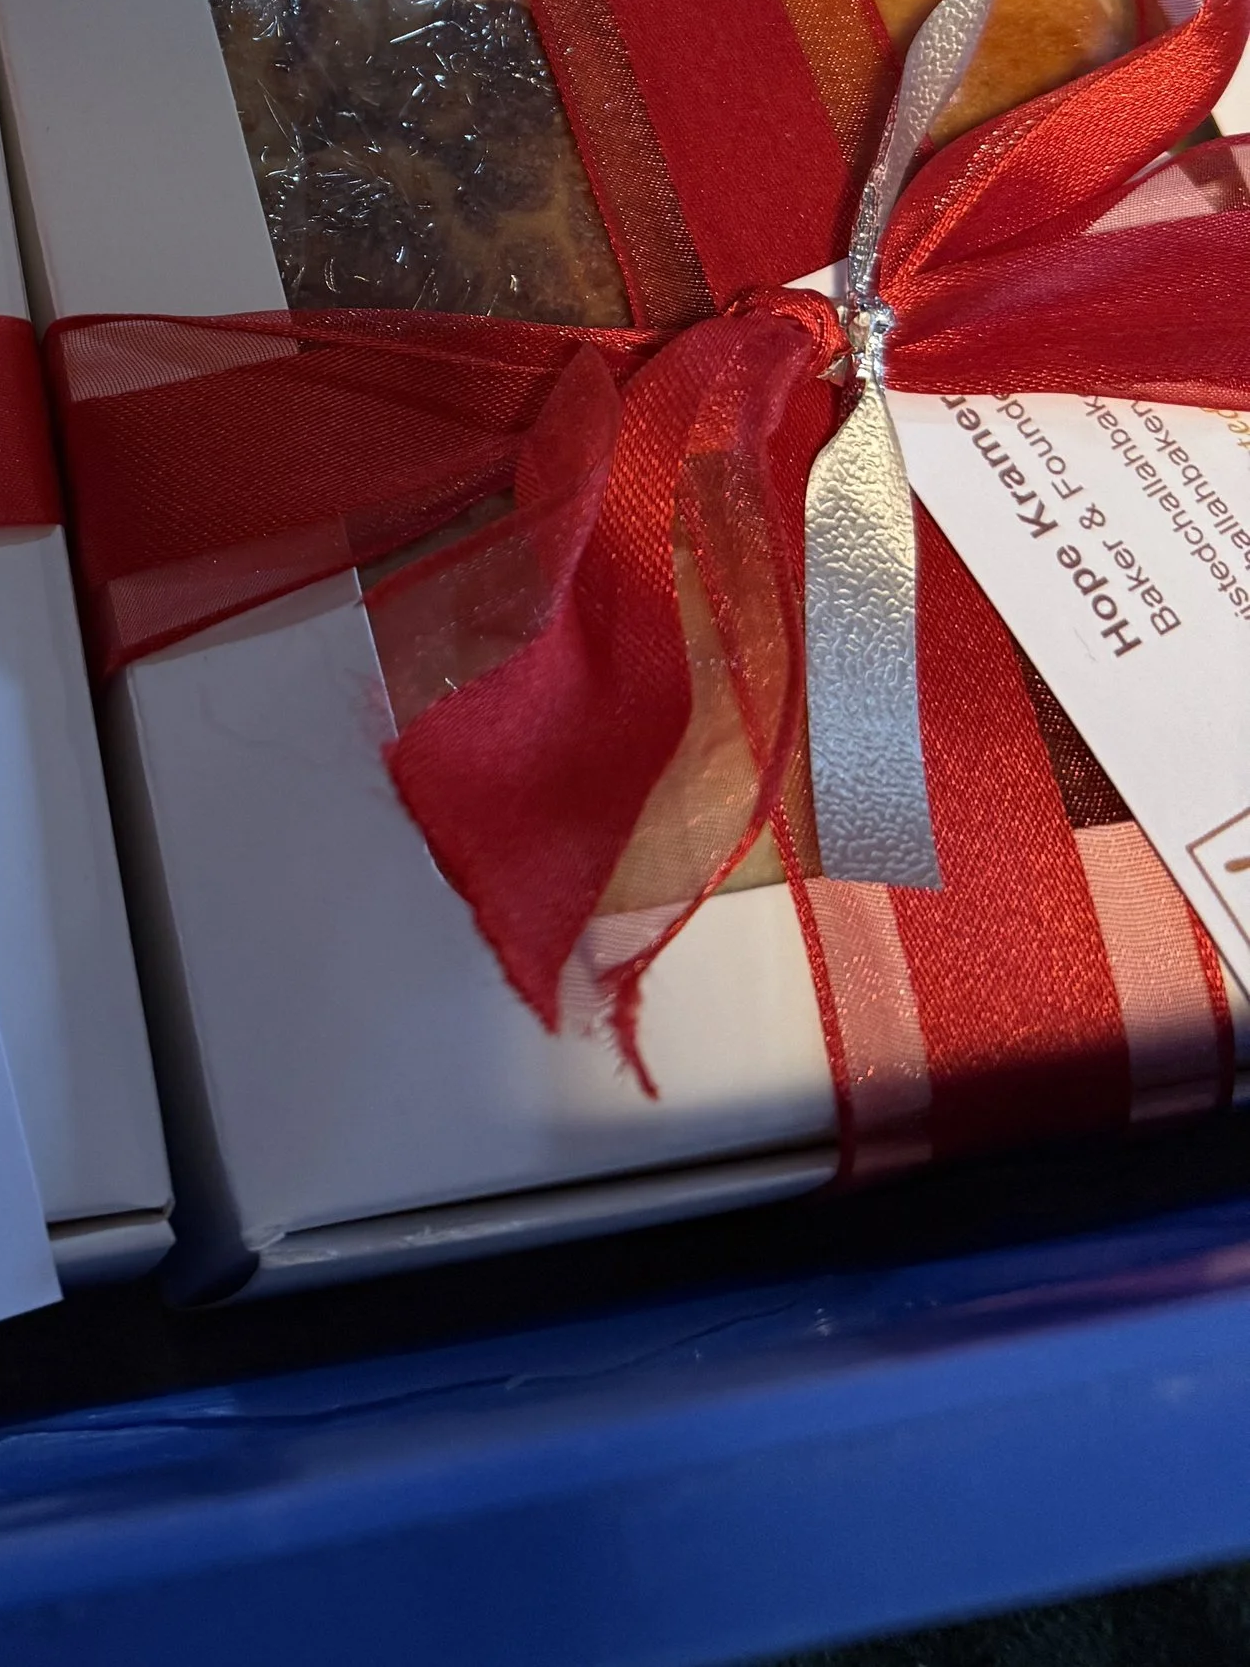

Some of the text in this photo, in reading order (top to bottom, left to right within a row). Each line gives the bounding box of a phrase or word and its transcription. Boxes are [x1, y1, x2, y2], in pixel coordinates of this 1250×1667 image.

[940, 396, 1142, 657] Hope Kramer
[1078, 502, 1106, 530] &
[1102, 540, 1182, 637] Baker
